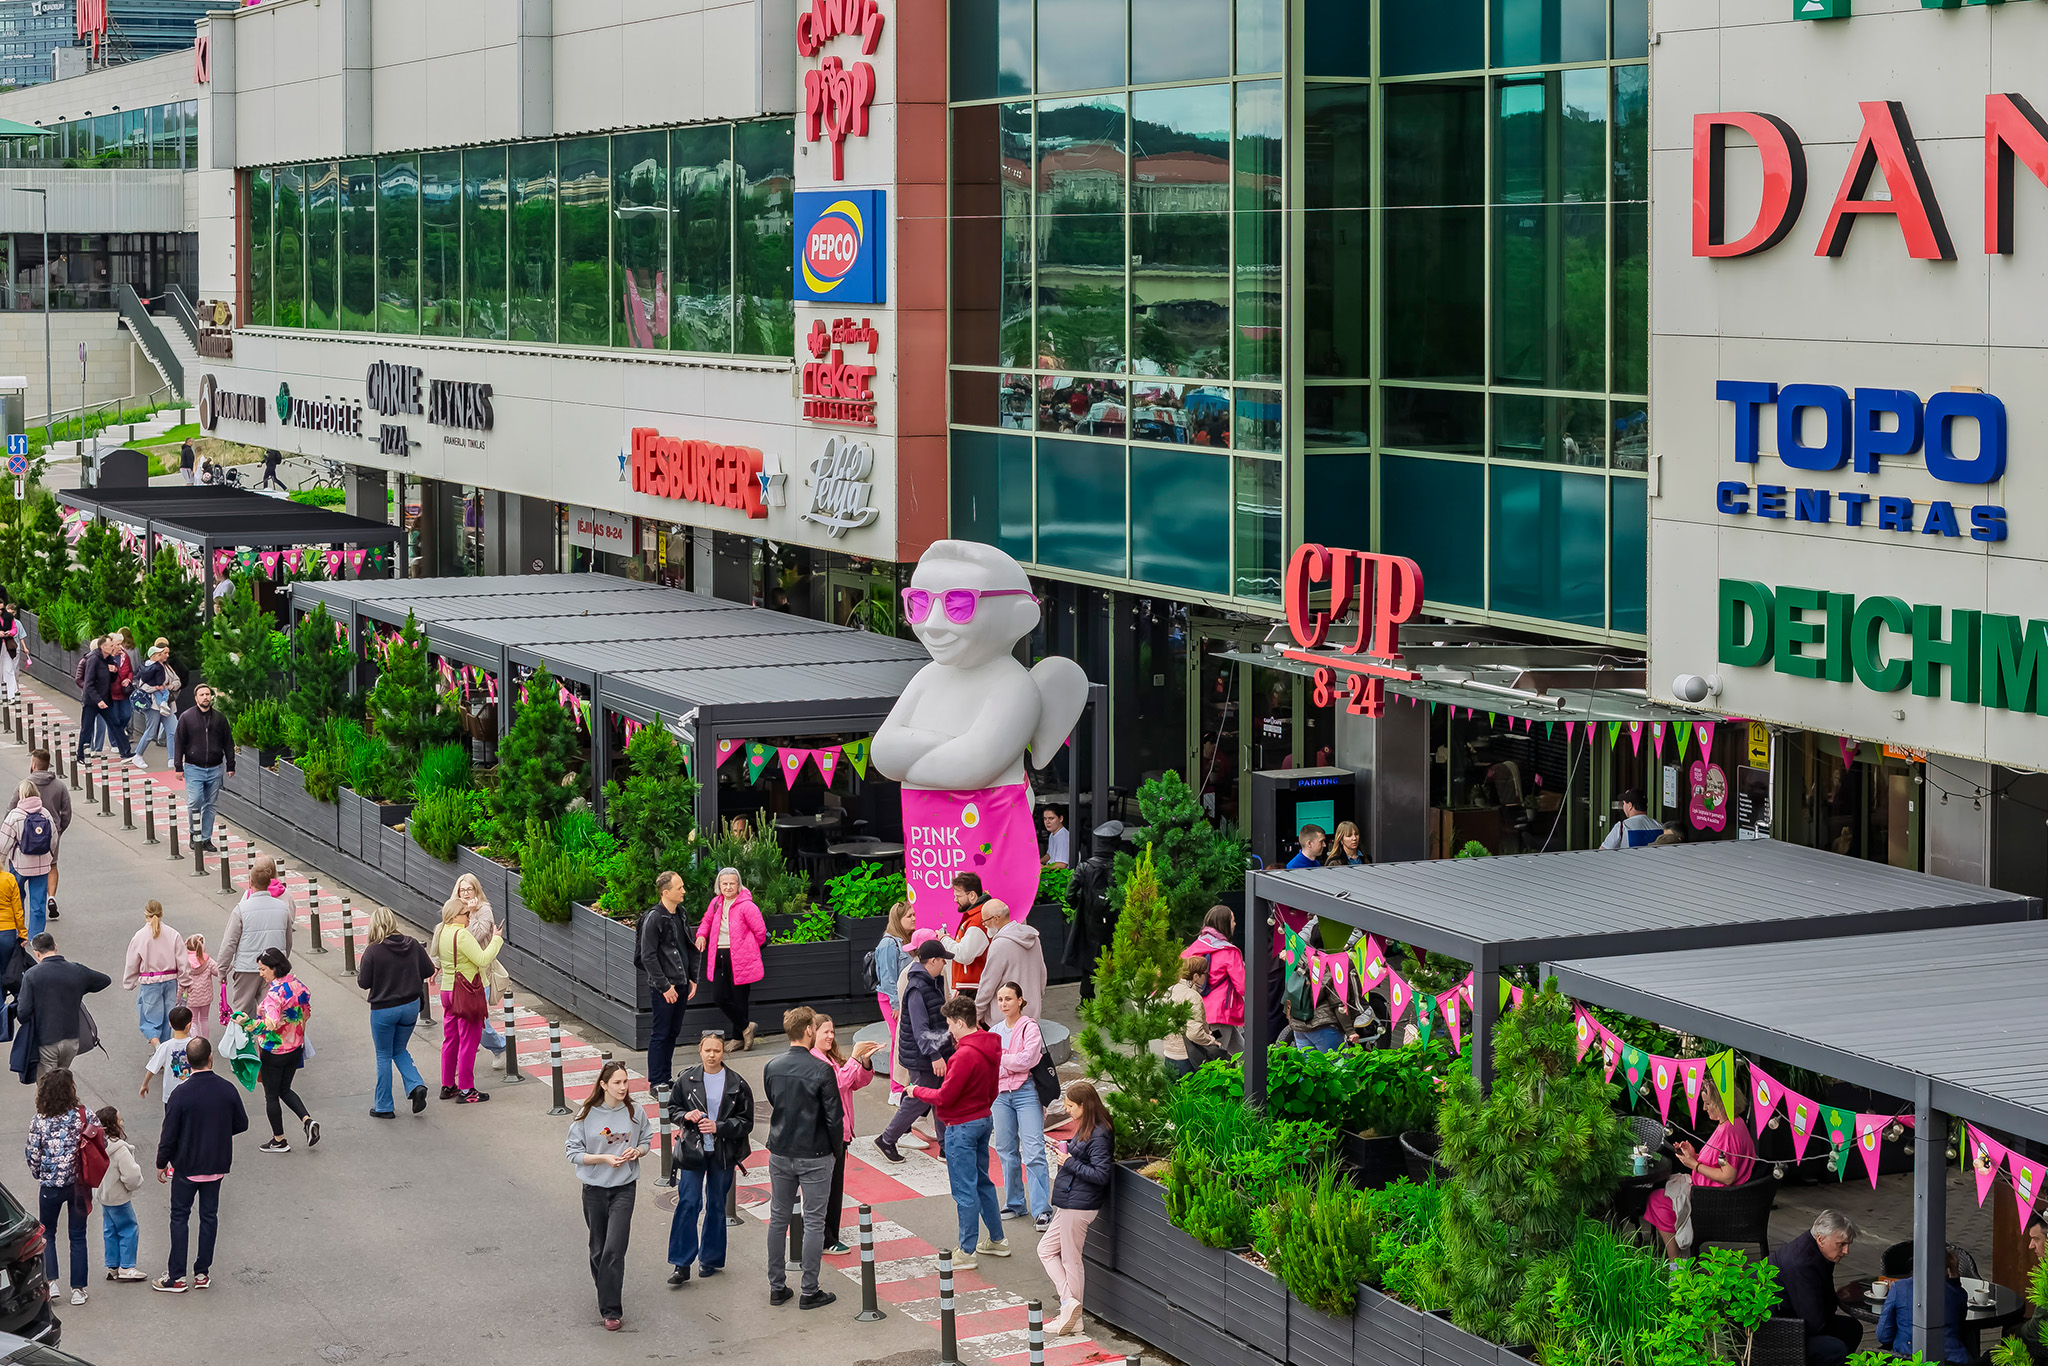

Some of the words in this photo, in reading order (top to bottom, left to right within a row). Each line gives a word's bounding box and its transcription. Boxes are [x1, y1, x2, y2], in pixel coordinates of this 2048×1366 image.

[797, 0, 884, 57] CANDY
[811, 233, 853, 261] PEPCO
[366, 360, 424, 416] CHARLIE
[803, 349, 876, 400] rieker
[215, 388, 266, 424] MANAMI
[1716, 379, 2008, 484] TOPO
[380, 424, 408, 457] PIZZA
[631, 427, 767, 519] HESBURGER
[605, 525, 623, 540] 8-24
[1716, 481, 2008, 542] CENTRAS
[1285, 543, 1424, 660] CUP
[1718, 578, 2048, 717] DEICHM
[1313, 667, 1385, 719] 8-24
[1298, 777, 1339, 787] PARKING
[910, 826, 961, 846] PINK
[910, 848, 966, 868] SOUP
[912, 870, 923, 880] IN
[924, 870, 966, 890] CU
